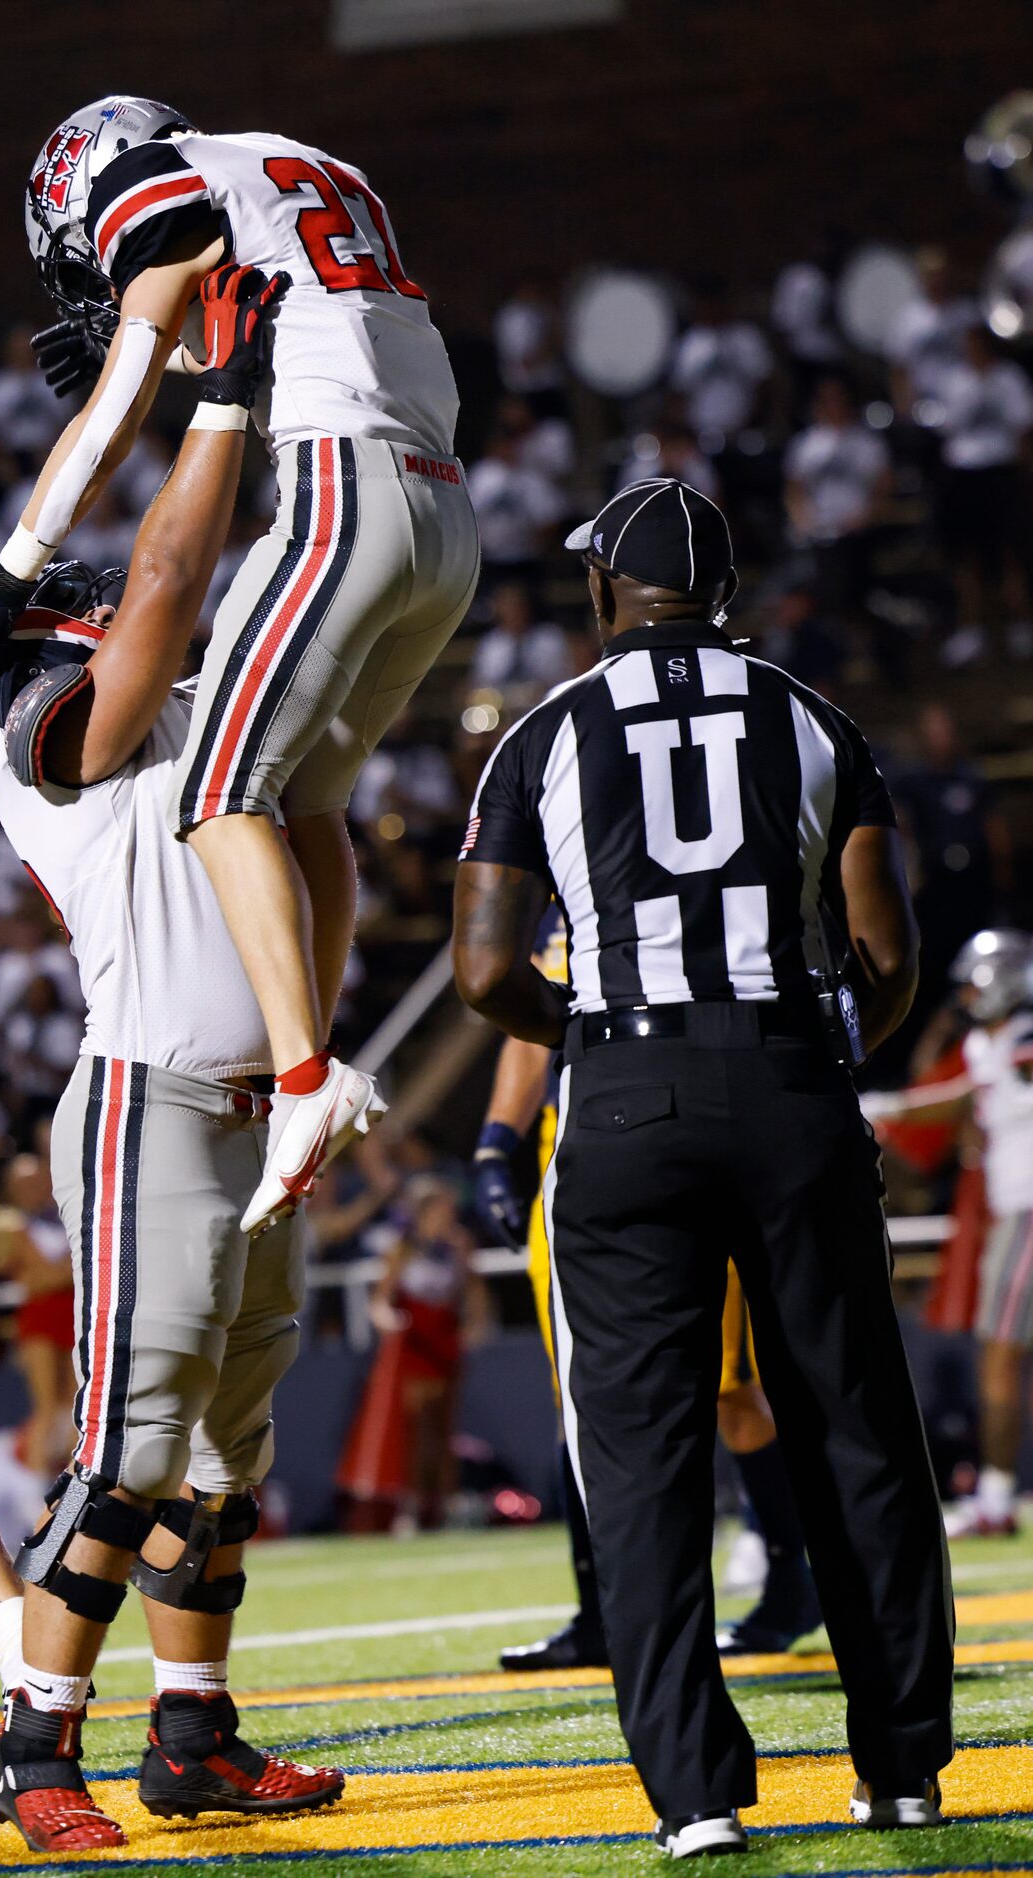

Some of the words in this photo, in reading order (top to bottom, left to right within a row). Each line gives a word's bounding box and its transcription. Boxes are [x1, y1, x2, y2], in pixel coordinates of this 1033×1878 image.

[40, 127, 77, 207] marcus
[403, 453, 461, 485] MARCUS
[624, 711, 747, 876] U
